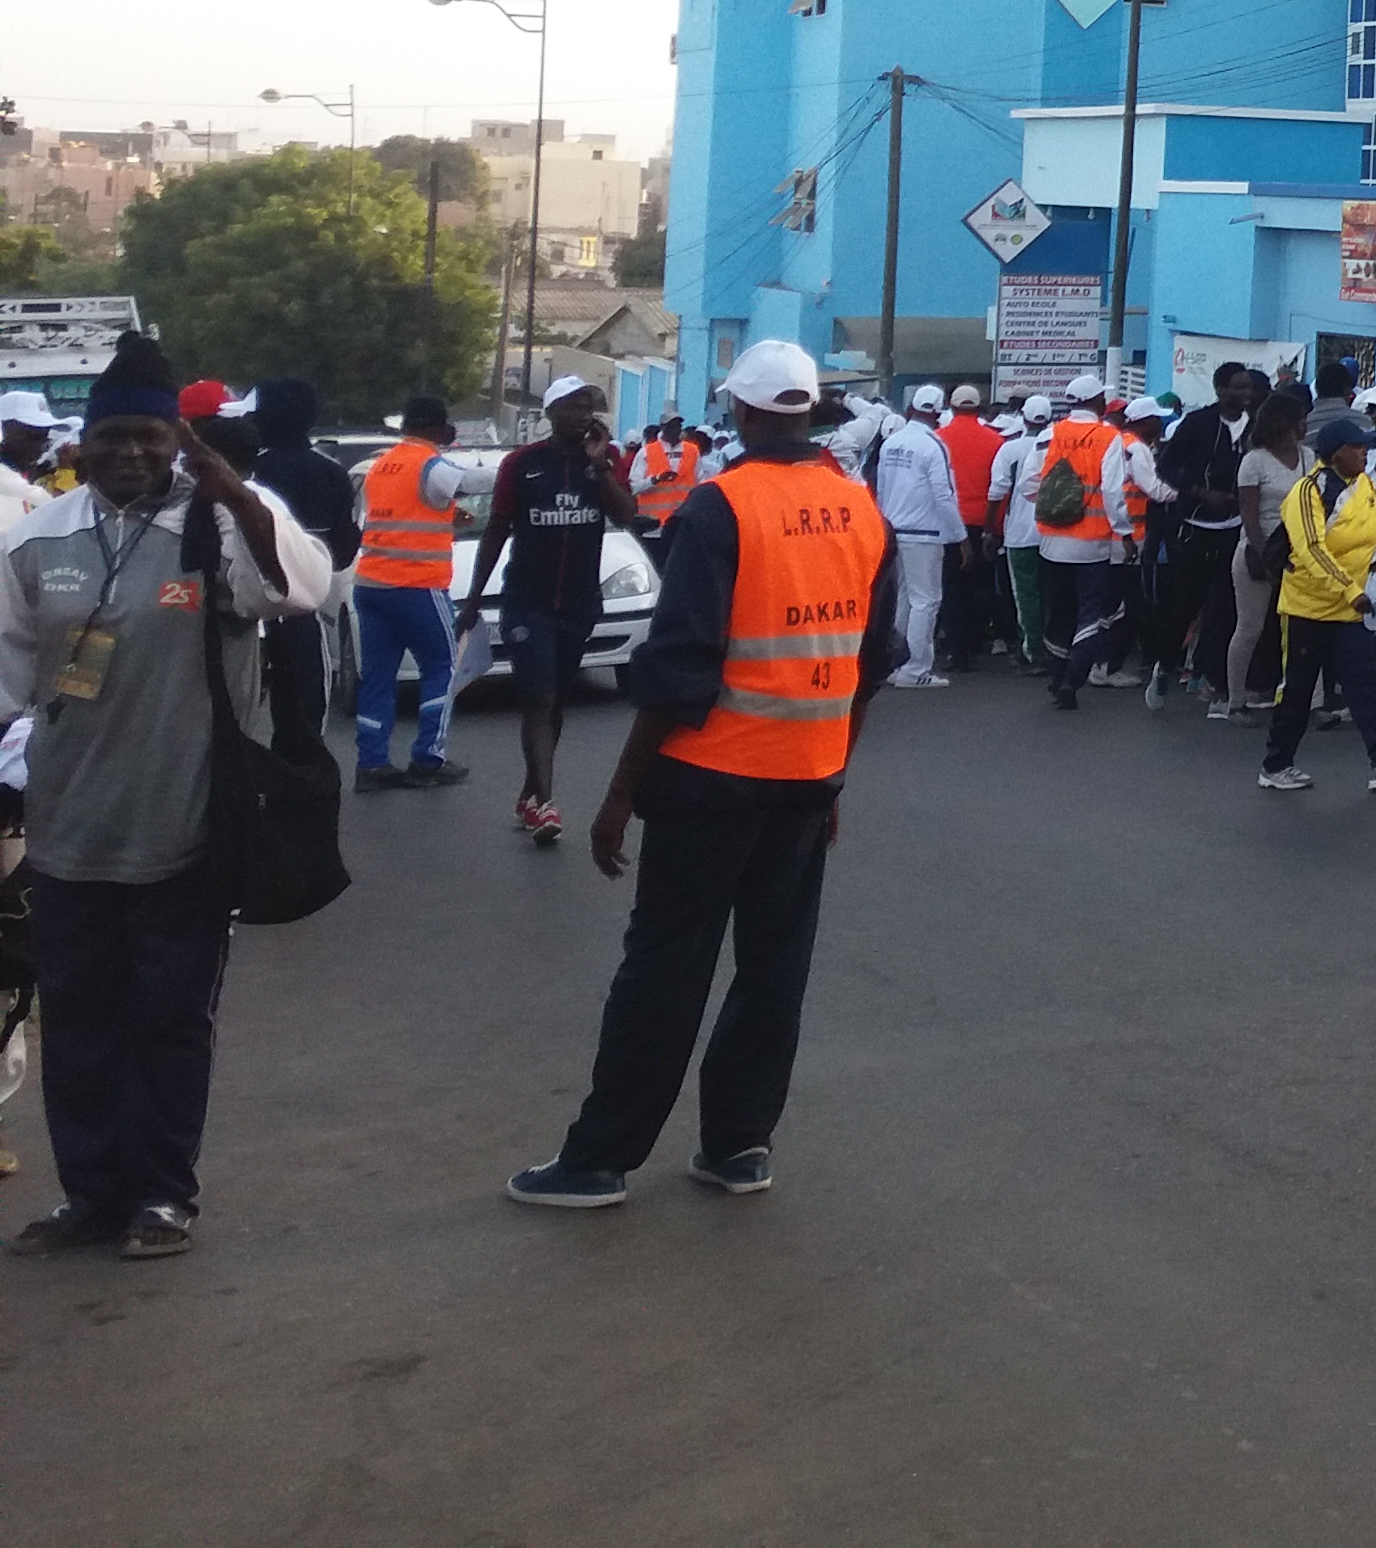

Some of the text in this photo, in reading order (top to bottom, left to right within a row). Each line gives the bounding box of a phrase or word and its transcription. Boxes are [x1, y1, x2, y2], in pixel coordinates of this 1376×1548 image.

[1012, 288, 1060, 297] SYSTEME
[555, 493, 580, 507] Fly
[782, 507, 851, 537] L.R.R.P
[786, 599, 858, 626] DAKAR
[811, 661, 831, 690] 43
